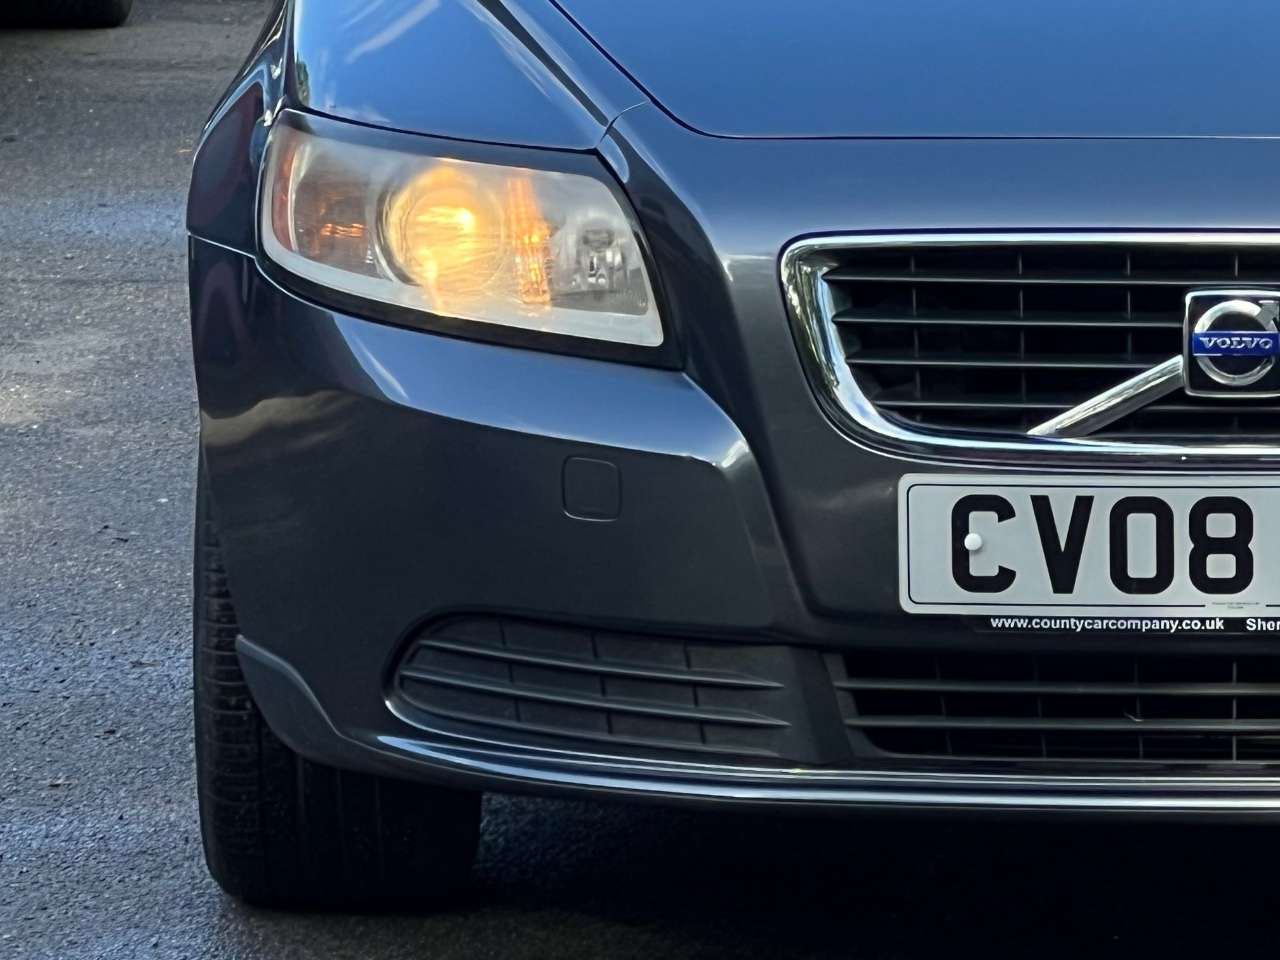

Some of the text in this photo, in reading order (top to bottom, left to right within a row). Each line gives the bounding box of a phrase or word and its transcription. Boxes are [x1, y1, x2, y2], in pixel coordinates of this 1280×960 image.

[1199, 337, 1274, 349] VOLVO
[951, 494, 1255, 595] CV08
[990, 617, 1225, 633] www.countycarcompany.co.uk
